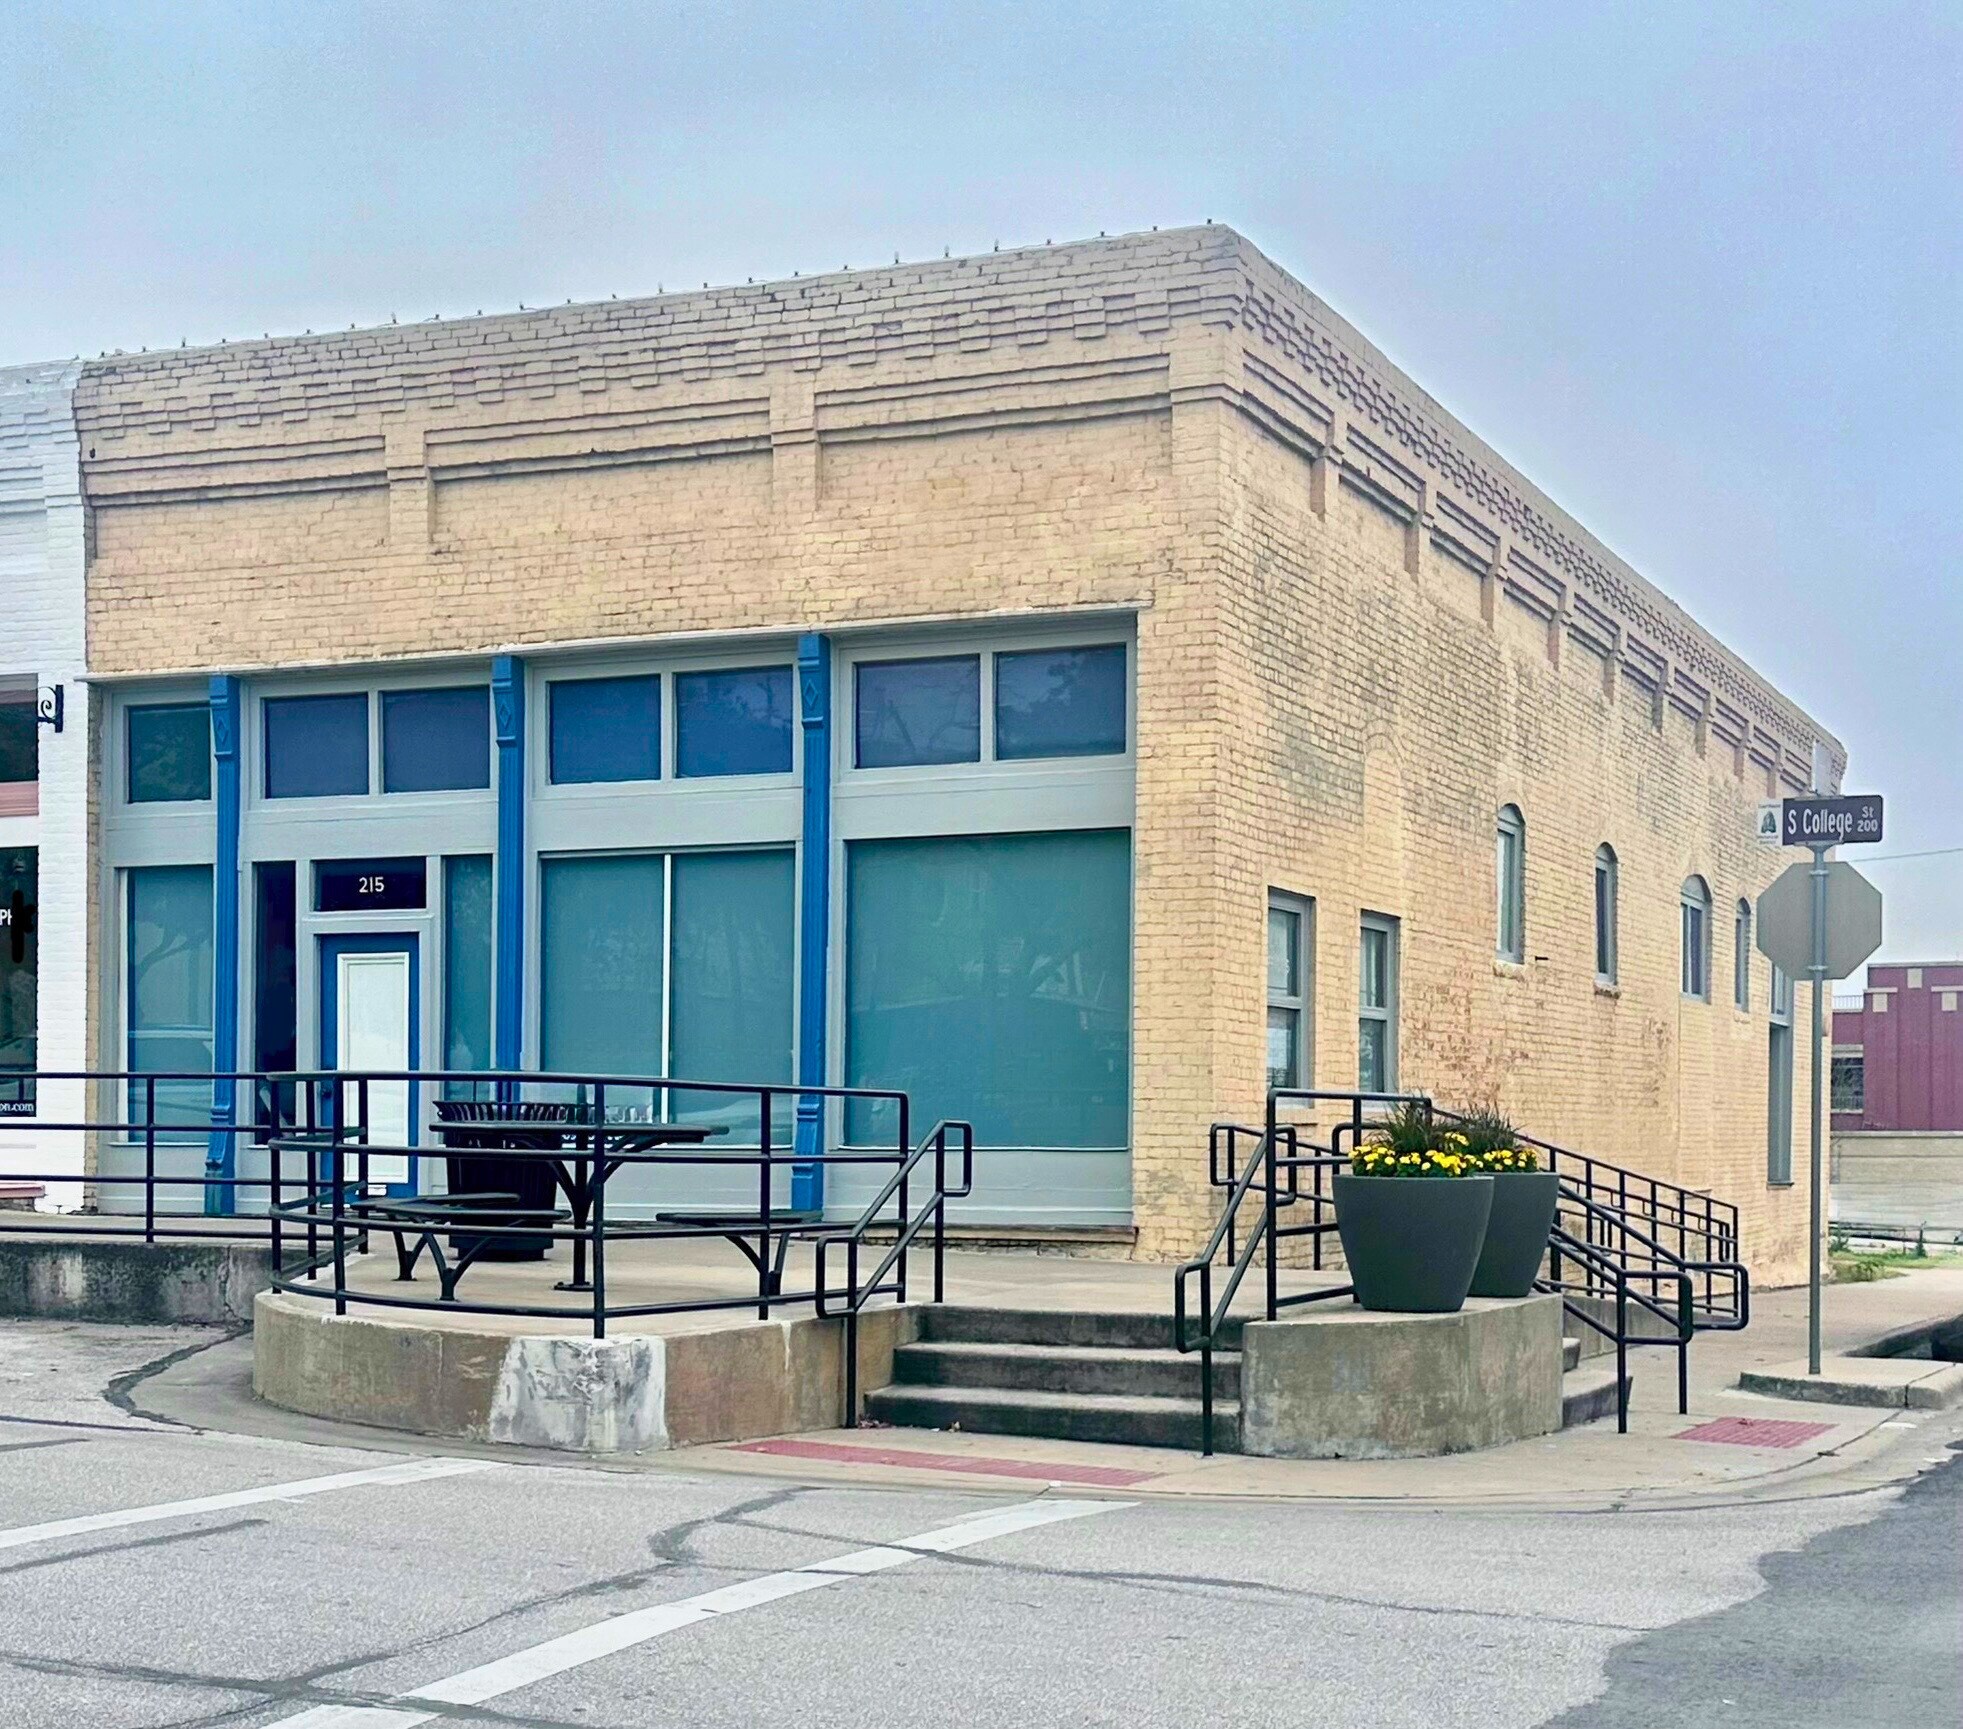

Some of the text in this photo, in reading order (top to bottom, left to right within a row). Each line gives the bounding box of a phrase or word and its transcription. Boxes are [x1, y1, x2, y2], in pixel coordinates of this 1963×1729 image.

[1787, 806, 1875, 842] S College St
[1857, 819, 1879, 833] 200
[358, 876, 385, 893] 215
